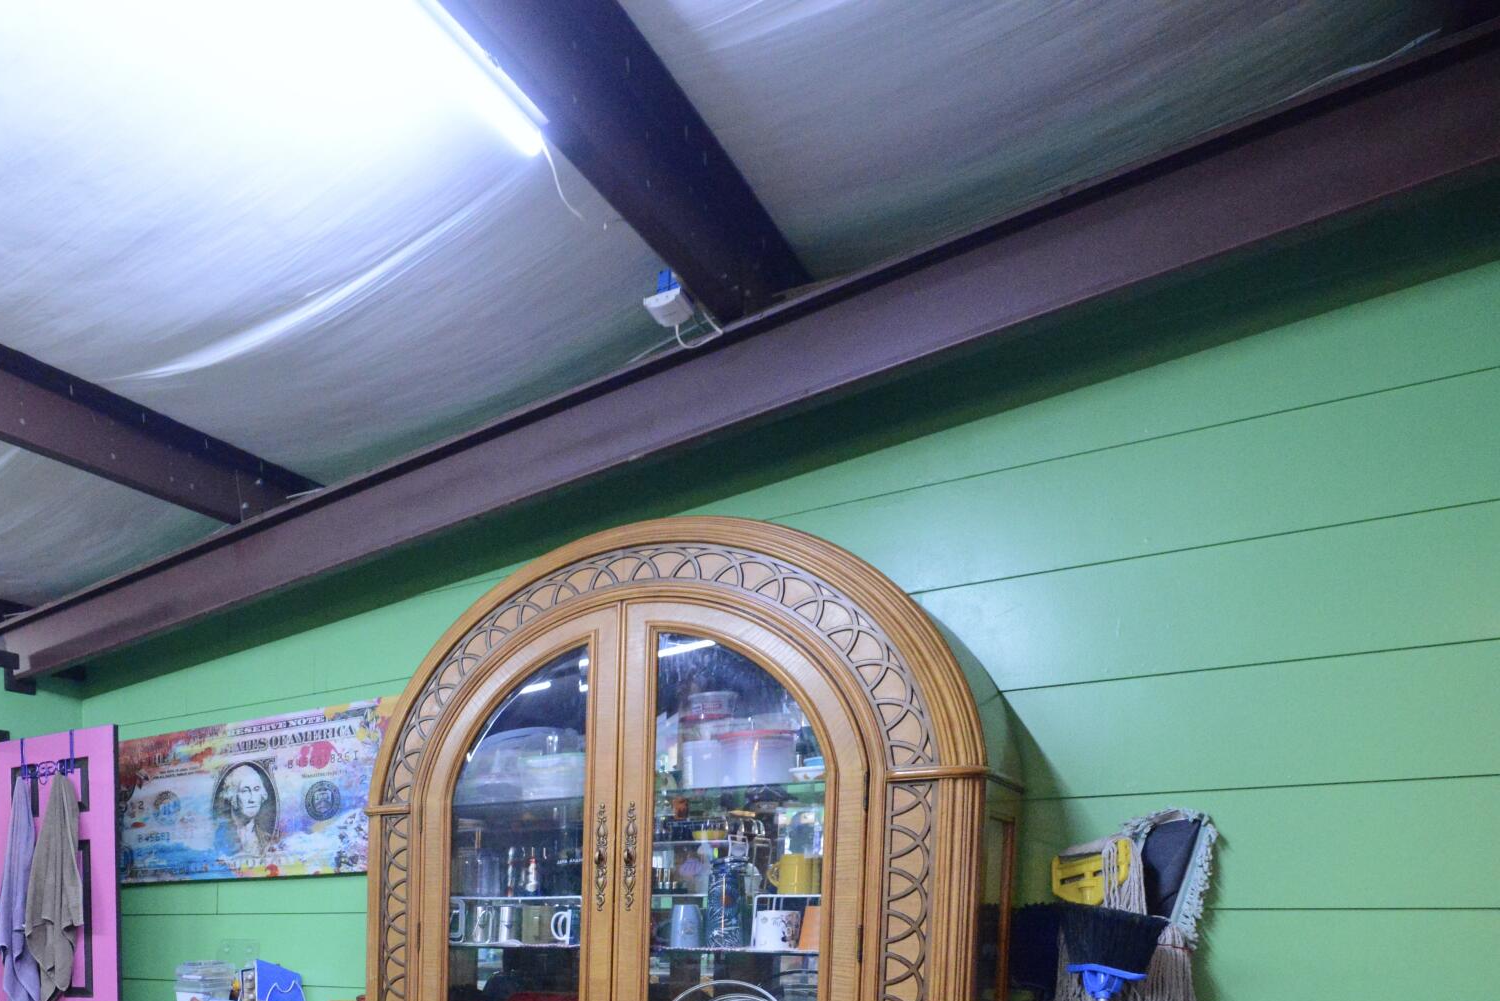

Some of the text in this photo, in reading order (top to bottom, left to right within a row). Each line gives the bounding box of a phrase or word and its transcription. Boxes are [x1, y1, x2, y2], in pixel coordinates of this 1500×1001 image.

[289, 714, 326, 726] NOTE
[269, 734, 287, 749] OF
[288, 724, 355, 745] AMERICA
